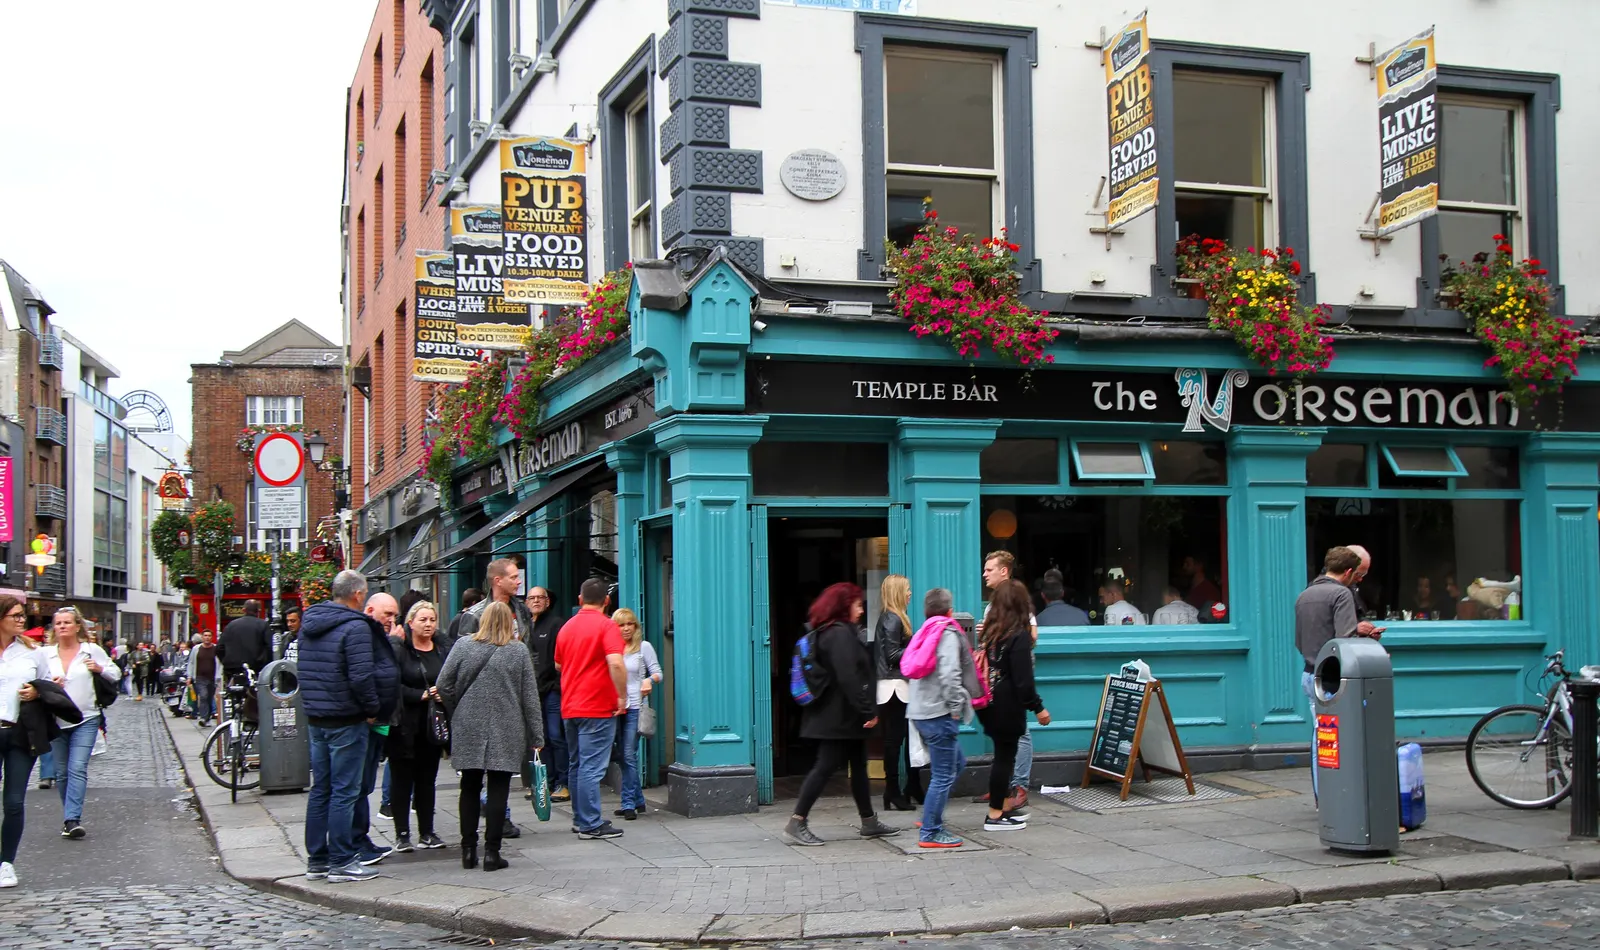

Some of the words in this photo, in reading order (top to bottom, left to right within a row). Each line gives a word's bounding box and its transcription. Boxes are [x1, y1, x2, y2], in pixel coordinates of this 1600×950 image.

[1109, 63, 1151, 120] PUB
[1110, 102, 1144, 133] VENUE
[1144, 96, 1153, 113] &
[1381, 94, 1435, 143] LIVE
[1111, 112, 1153, 145] RESTAURANT
[1111, 126, 1155, 169] FOOD
[1383, 121, 1436, 164] MUSIC
[1111, 148, 1157, 186] SERVED
[1383, 161, 1404, 178] TILL
[1405, 156, 1411, 169] 7
[1411, 147, 1436, 166] DAYS
[1383, 172, 1404, 189] LATE
[504, 177, 583, 210] PUB
[505, 207, 565, 222] VENUE
[569, 210, 583, 223] &
[505, 222, 584, 234] RESTAURANT
[504, 233, 583, 255] FOOD
[456, 254, 504, 276] LIV
[505, 253, 584, 270] SERVED
[456, 276, 503, 292] MUS
[507, 268, 555, 277] 10.30-10PM
[557, 270, 584, 278] DAILY
[418, 298, 456, 311] LOCA
[457, 295, 486, 305] TILL
[487, 296, 494, 306] 7
[457, 304, 486, 313] LATE
[487, 305, 495, 313] A
[495, 305, 527, 314] WEEK!
[418, 309, 456, 318] INTERNAT
[418, 319, 456, 330] BOUTI
[417, 329, 456, 343] GINS
[852, 380, 946, 400] TEMPLE
[952, 383, 999, 402] BAR
[1091, 381, 1157, 412] The
[1174, 367, 1519, 433] Norseman
[604, 410, 618, 430] EST.
[490, 464, 503, 486] The
